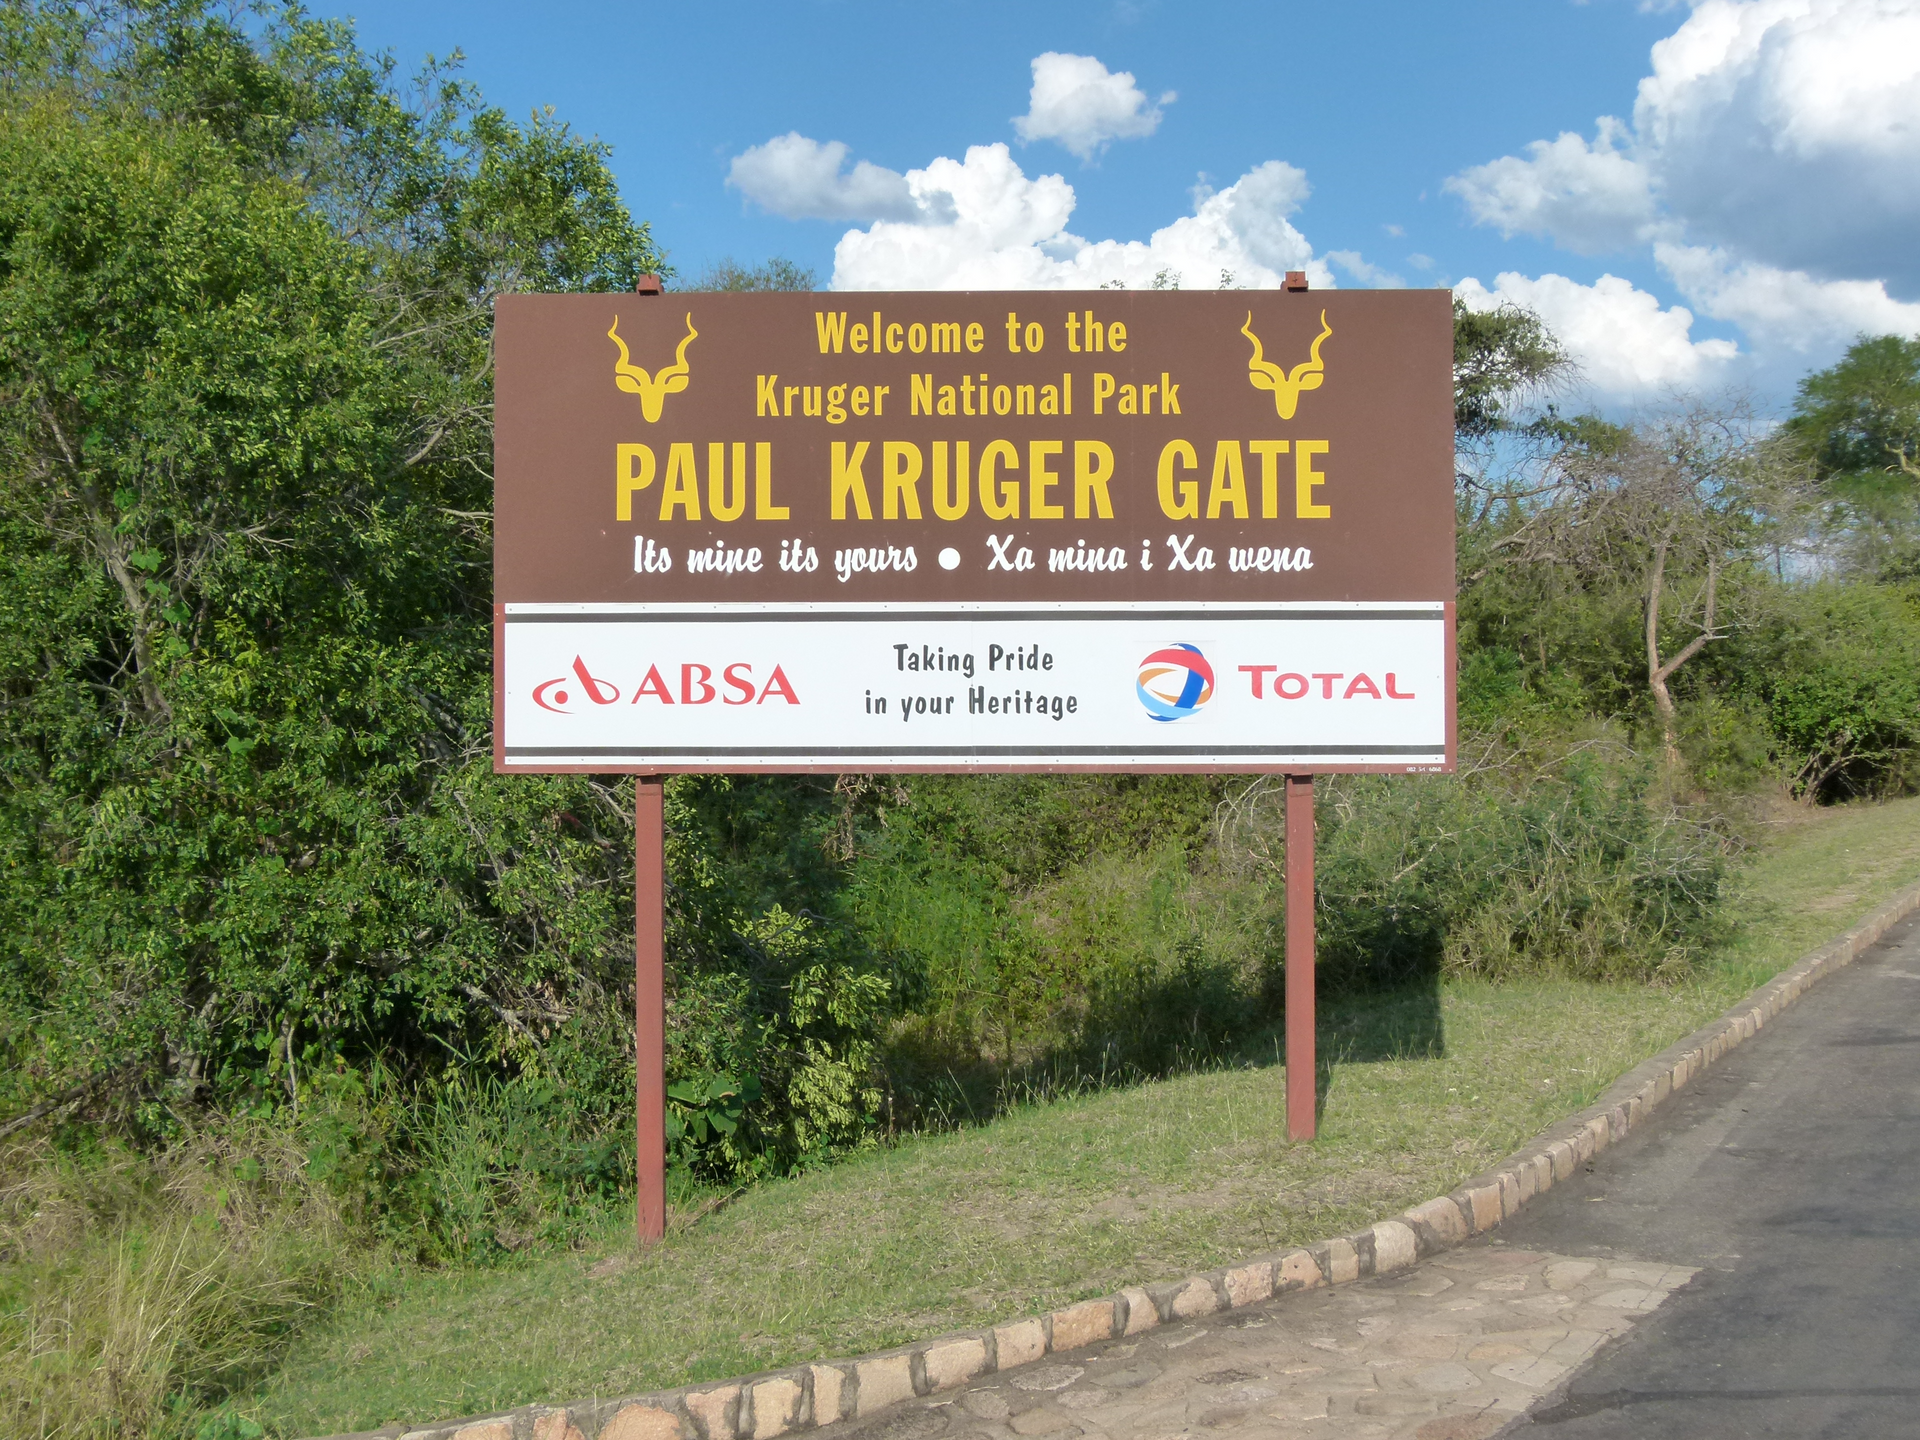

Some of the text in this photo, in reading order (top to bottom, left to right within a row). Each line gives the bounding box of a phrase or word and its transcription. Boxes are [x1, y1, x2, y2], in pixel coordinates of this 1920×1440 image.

[815, 310, 1127, 354] Welcome to the
[757, 372, 1181, 424] Kruger National Park
[616, 439, 1331, 522] PAUL KRUGER GATE
[634, 536, 917, 582] Its mine its yours
[986, 535, 1314, 572] Xa mina i Xa wena
[893, 644, 1052, 678] Taking Pride
[632, 663, 799, 705] ABSA
[1239, 666, 1415, 699] TOTAL
[866, 686, 1077, 722] in your Heritage
